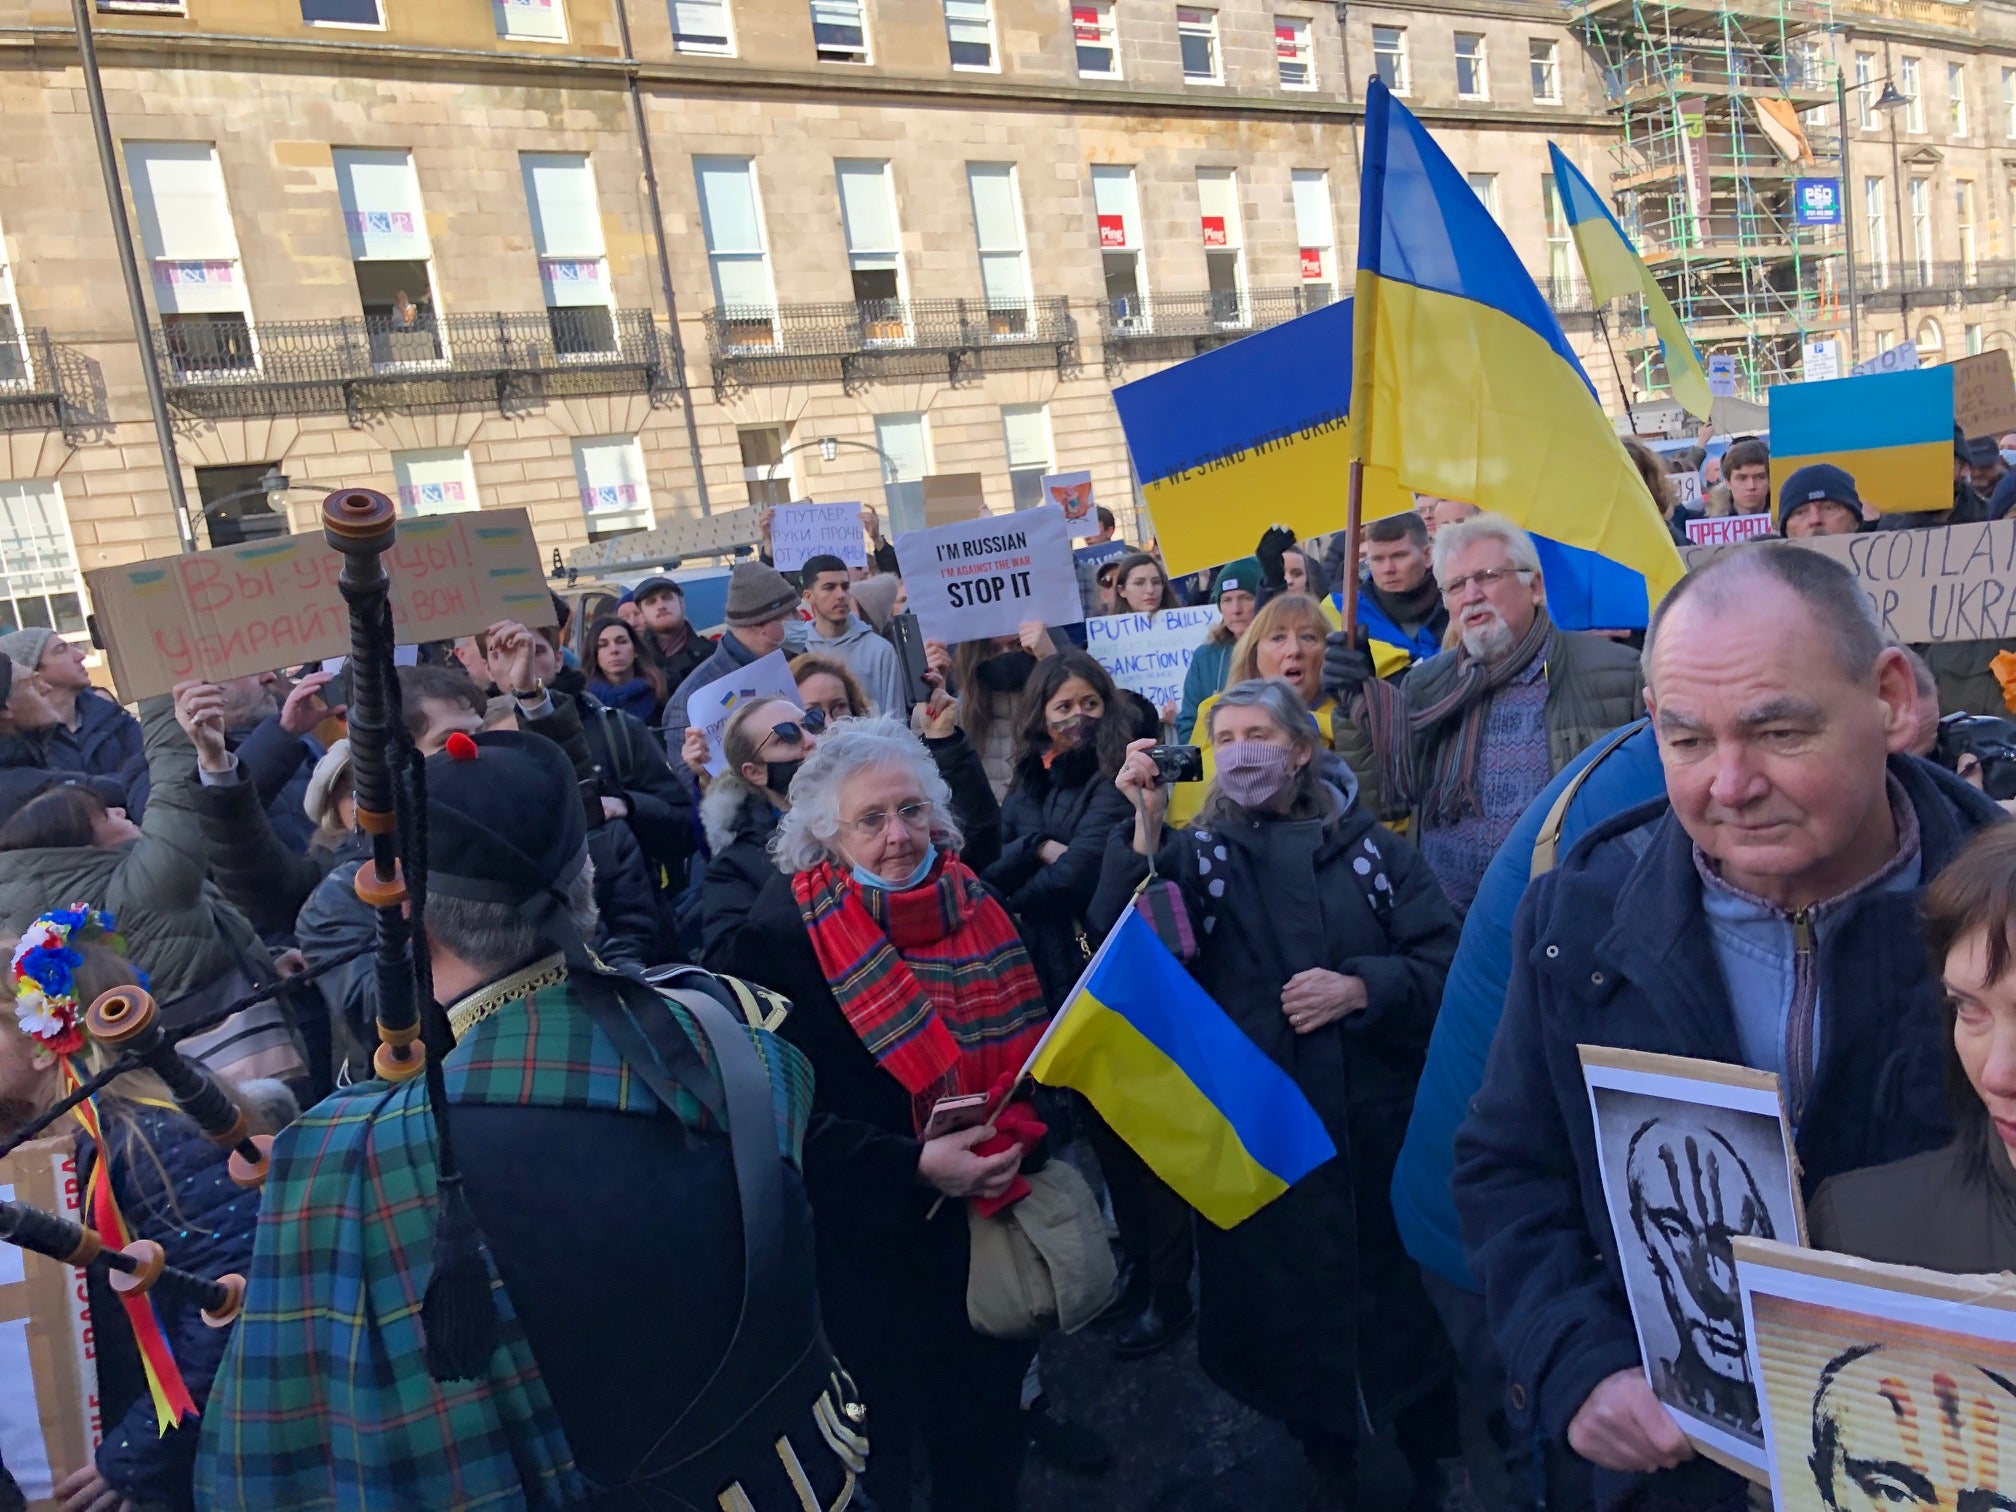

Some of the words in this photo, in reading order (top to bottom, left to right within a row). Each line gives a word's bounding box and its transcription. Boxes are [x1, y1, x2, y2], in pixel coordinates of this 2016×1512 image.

[1165, 460, 1192, 486] WE
[1194, 442, 1246, 476] STAND
[1252, 424, 1294, 457] WITH
[773, 529, 811, 542] РУКИ
[821, 526, 863, 540] ПРОЧЬ
[936, 543, 960, 561] I'M
[963, 532, 1027, 557] RUSSIAN
[774, 548, 792, 562] ОТ
[940, 568, 955, 579] I'M
[957, 561, 992, 577] AGAINST
[994, 559, 1011, 571] THE
[1011, 556, 1031, 567] WAR
[947, 576, 1005, 608] STOP
[1010, 571, 1031, 598] IT
[1089, 614, 1152, 641] PUTIN
[1165, 610, 1213, 631] BULLY
[1097, 650, 1178, 675] SANCTION
[1150, 684, 1182, 706] ZONE
